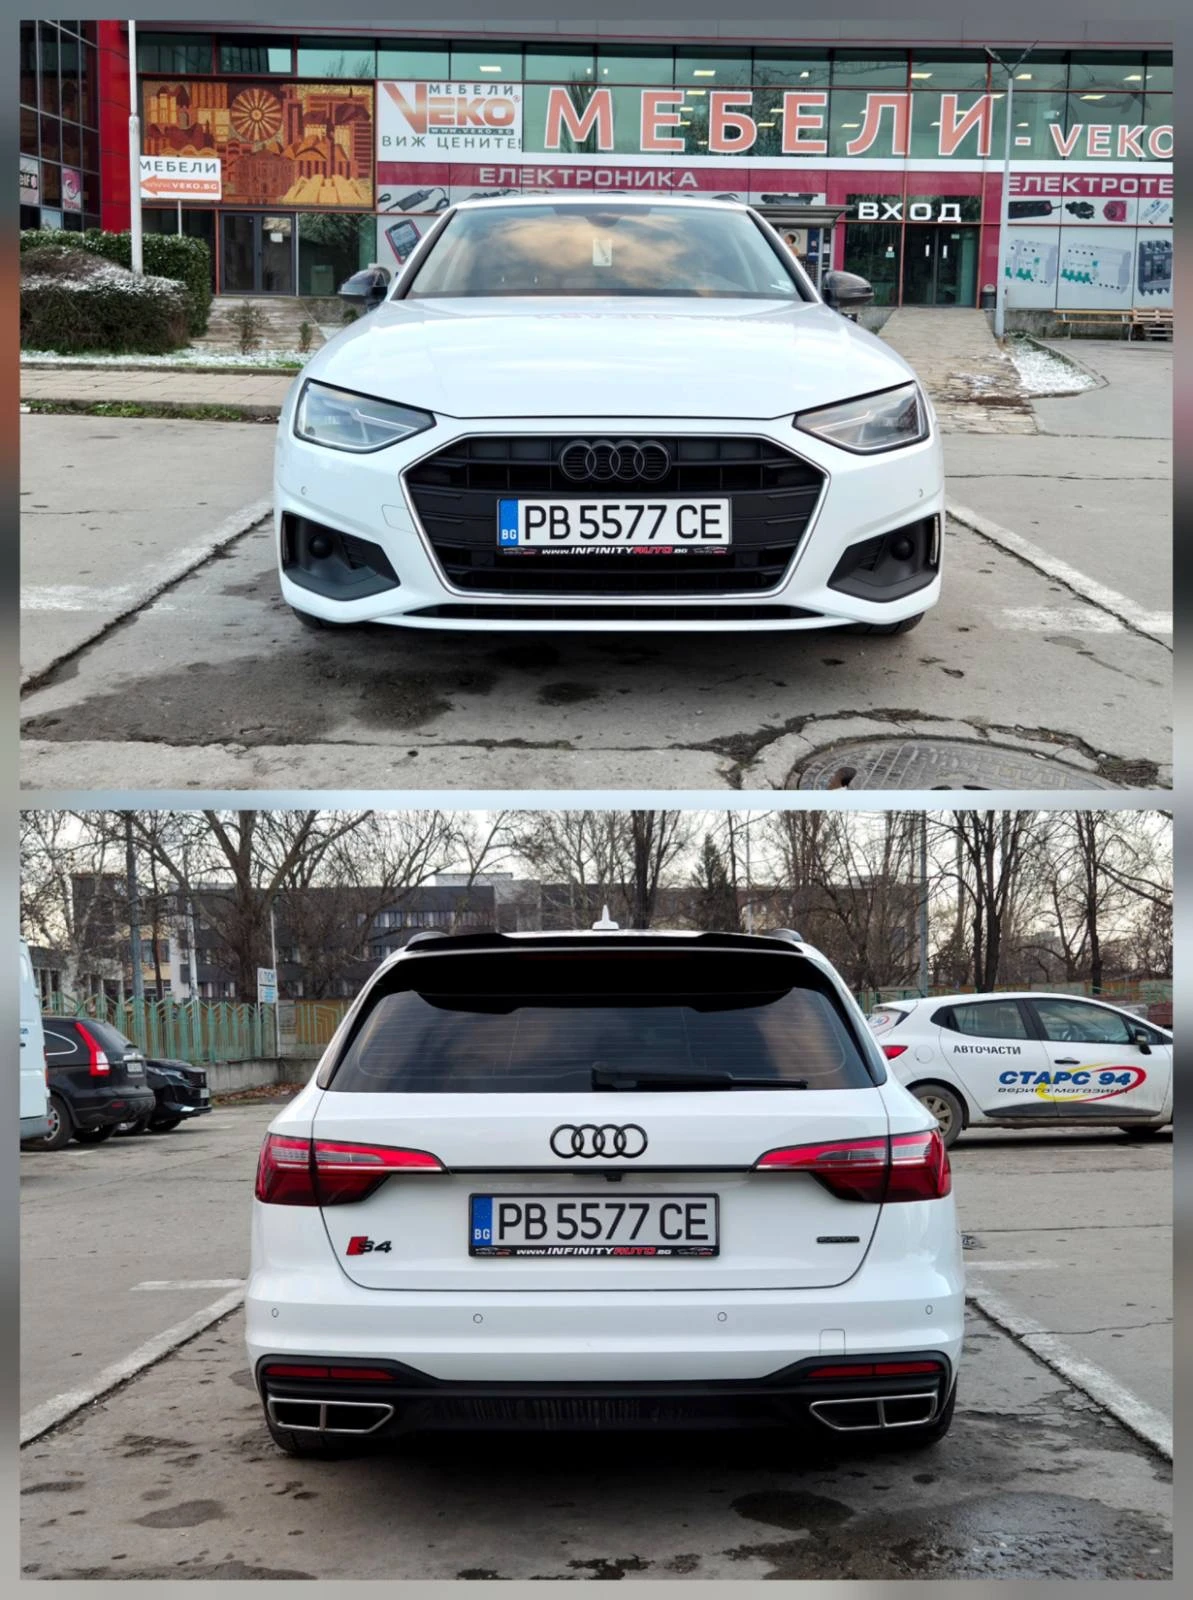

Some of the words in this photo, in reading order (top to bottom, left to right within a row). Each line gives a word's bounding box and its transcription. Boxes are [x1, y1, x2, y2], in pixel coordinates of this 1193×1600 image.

[428, 84, 514, 95] МЕБЕЛИ
[382, 83, 516, 134] VEKO
[543, 87, 993, 157] МЕБЕЛИ
[1049, 124, 1173, 158] VEKO
[382, 136, 426, 147] ВИЖ
[436, 138, 521, 150] ЦЕНИТЕ!
[140, 160, 217, 174] МЕБЕЛИ
[479, 168, 698, 187] ЕЛЕКТРОНИКА
[1008, 176, 1173, 194] ЕЛЕКТРОТЕ
[858, 202, 962, 223] ВХОД
[524, 505, 571, 540] PB
[579, 504, 668, 540] 5577
[676, 504, 722, 539] CE
[501, 529, 517, 540] BG
[953, 1045, 1022, 1055] АВТОЧАСТИ
[999, 1070, 1091, 1085] СТАРС
[1098, 1072, 1131, 1086] 94
[498, 1203, 548, 1240] PB
[556, 1203, 650, 1240] 5577
[659, 1203, 709, 1240] CE
[474, 1229, 491, 1240] BG
